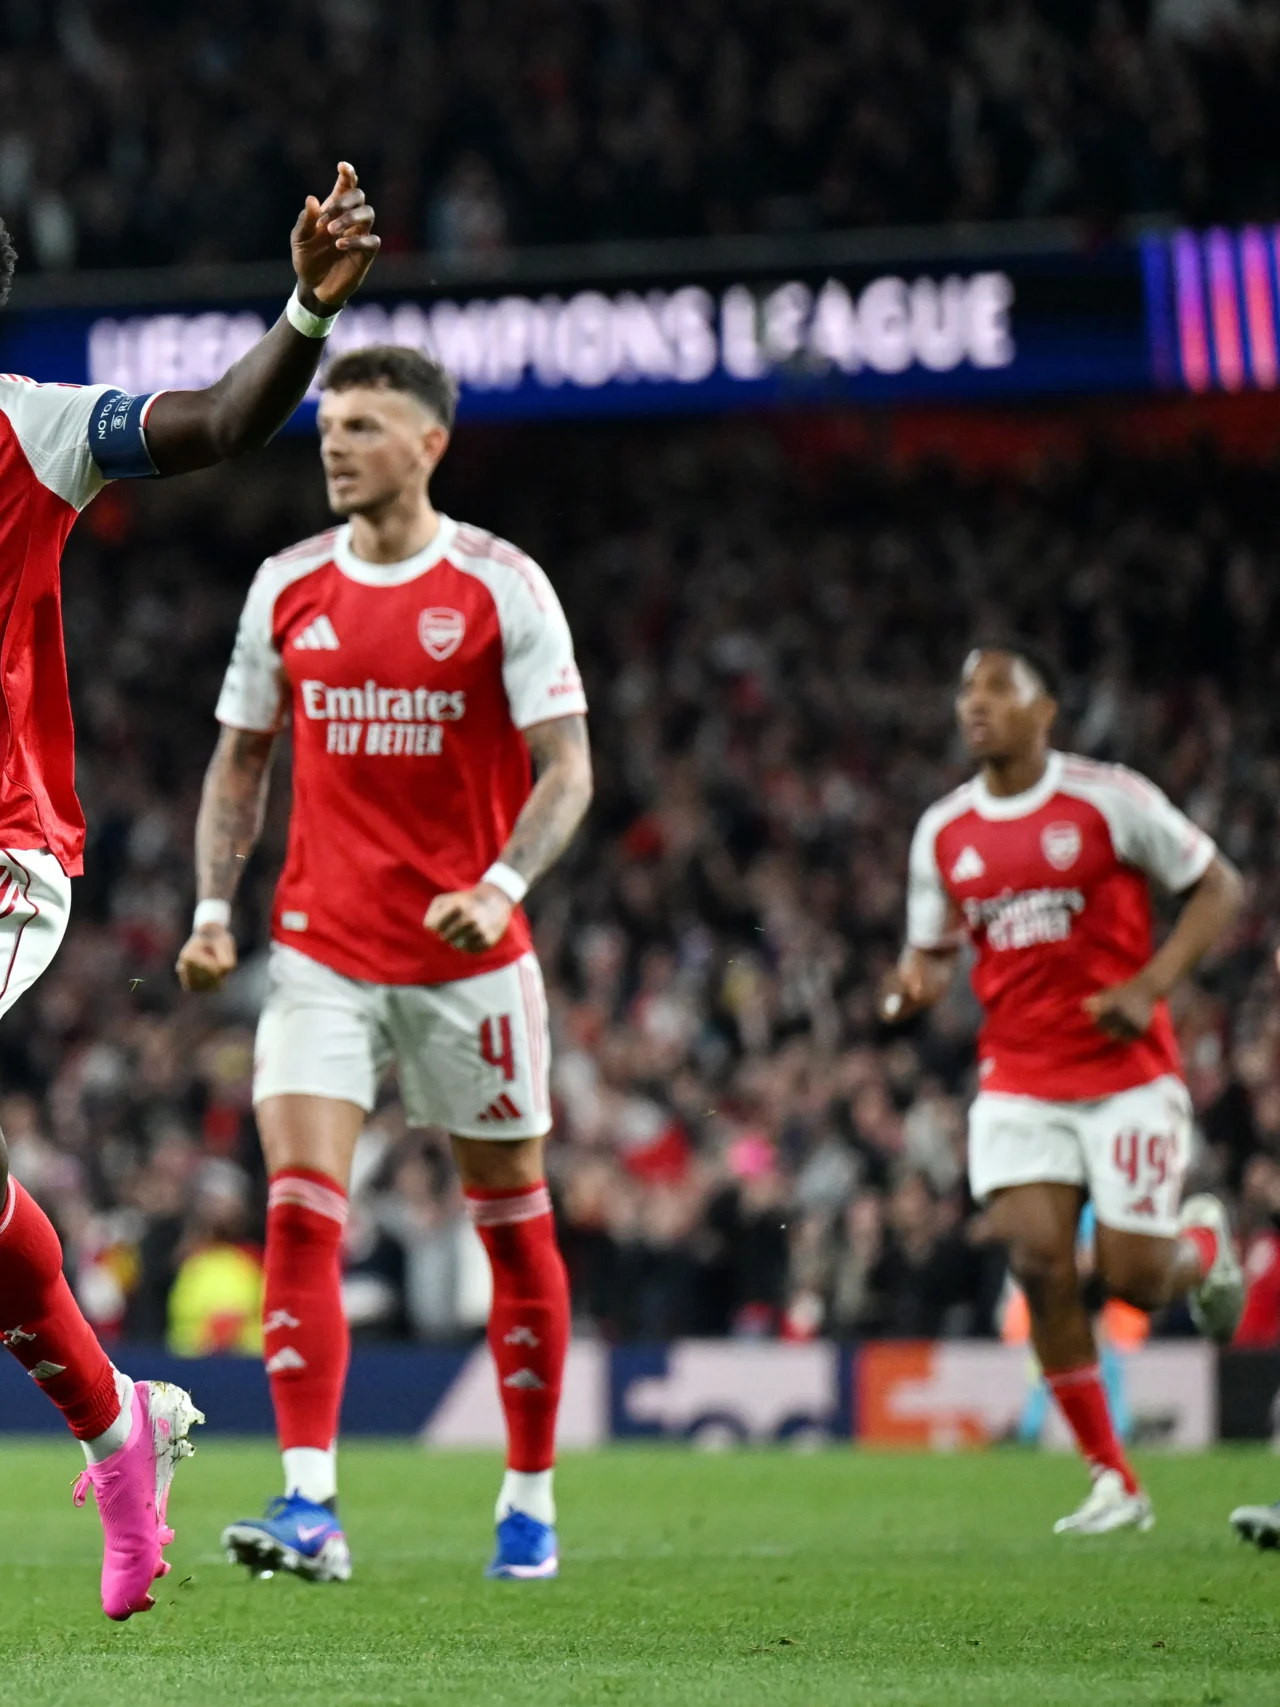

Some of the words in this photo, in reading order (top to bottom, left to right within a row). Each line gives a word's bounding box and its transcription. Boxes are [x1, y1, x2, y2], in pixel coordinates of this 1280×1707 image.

[722, 271, 1014, 379] LEAGUE
[97, 420, 107, 439] NO
[301, 679, 466, 722] Emirates
[326, 721, 363, 756] FLY
[365, 722, 445, 756] BETTER
[479, 1013, 516, 1082] 4
[1113, 1130, 1168, 1186] 49
